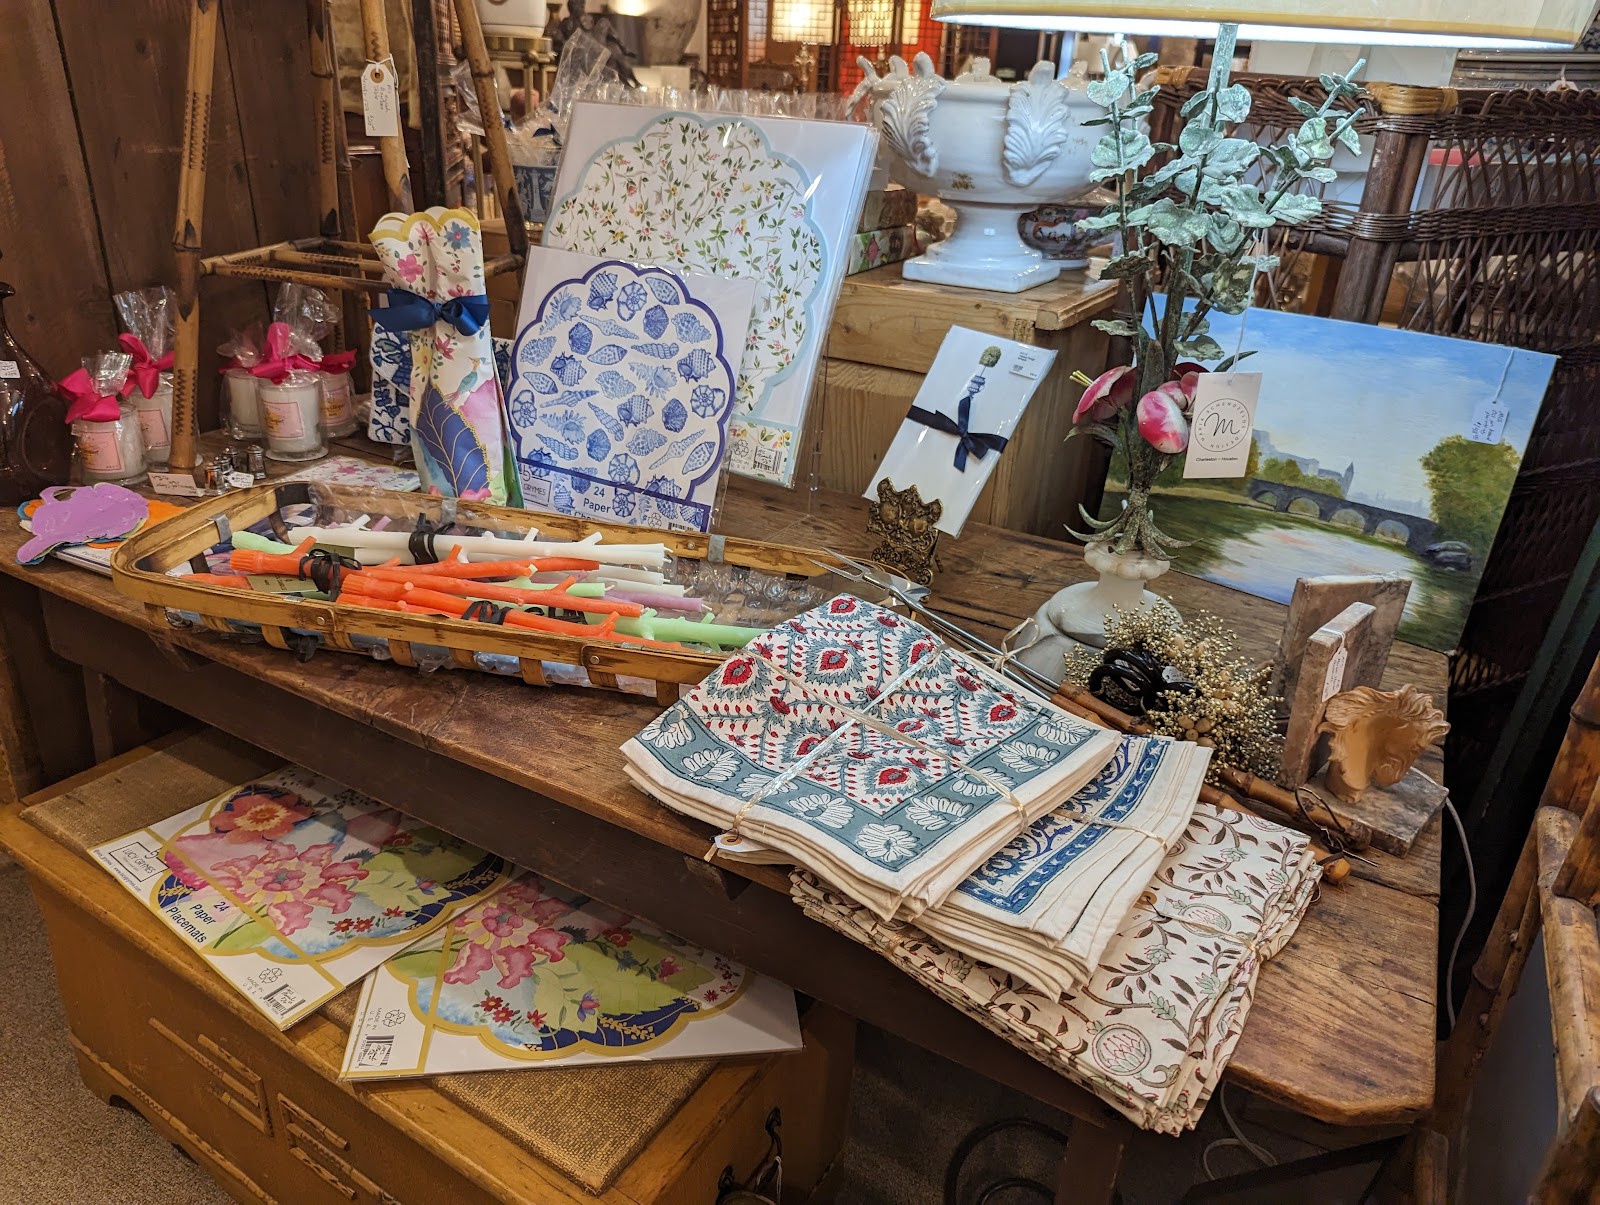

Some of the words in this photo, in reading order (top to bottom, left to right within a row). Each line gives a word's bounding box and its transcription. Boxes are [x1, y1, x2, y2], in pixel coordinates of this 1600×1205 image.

[523, 483, 547, 496] GRYMES
[593, 486, 605, 498] 24
[583, 497, 611, 514] Paper
[122, 848, 140, 860] LUCY
[134, 858, 157, 874] GRYMES
[189, 903, 217, 925] Paper
[213, 901, 231, 912] 24
[165, 906, 207, 943] Placemats
